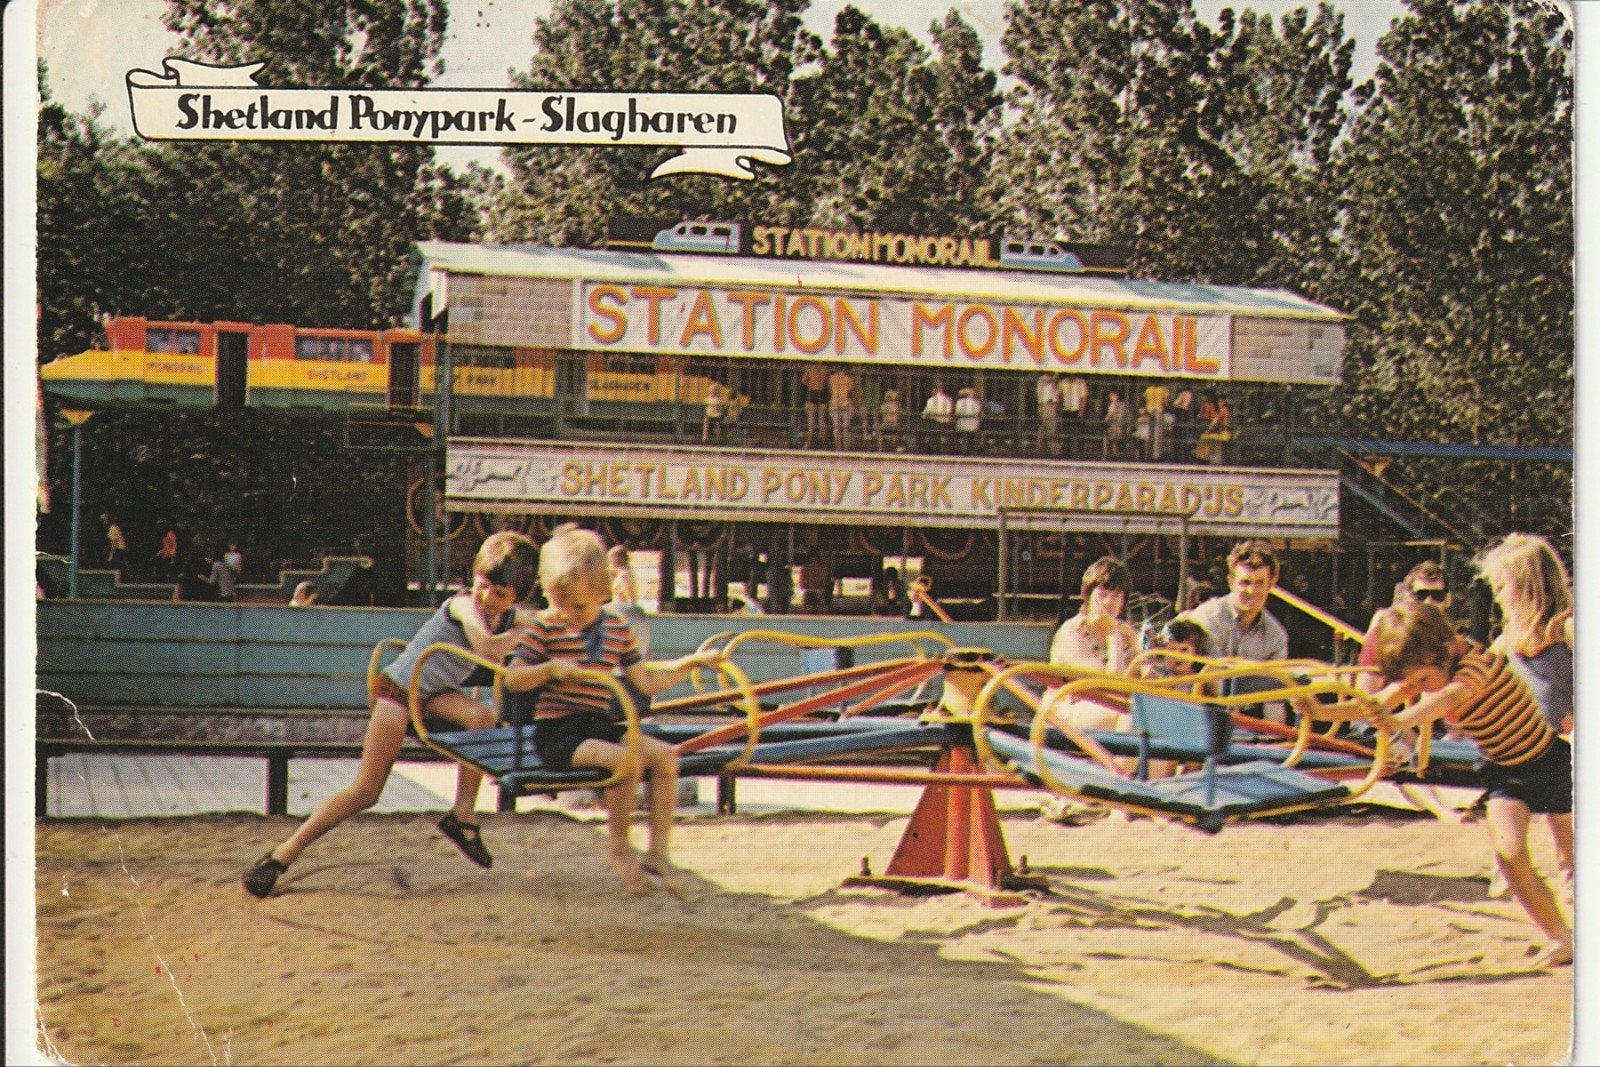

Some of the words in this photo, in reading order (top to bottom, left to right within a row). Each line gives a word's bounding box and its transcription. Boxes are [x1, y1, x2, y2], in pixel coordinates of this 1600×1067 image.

[752, 225, 870, 261] STATION
[872, 231, 1000, 268] MONORAIL
[587, 284, 879, 356] STATION
[911, 301, 1220, 373] MONORAIL
[560, 460, 750, 502] SHETLAND
[760, 466, 853, 505] PONY
[863, 471, 953, 510] PARK
